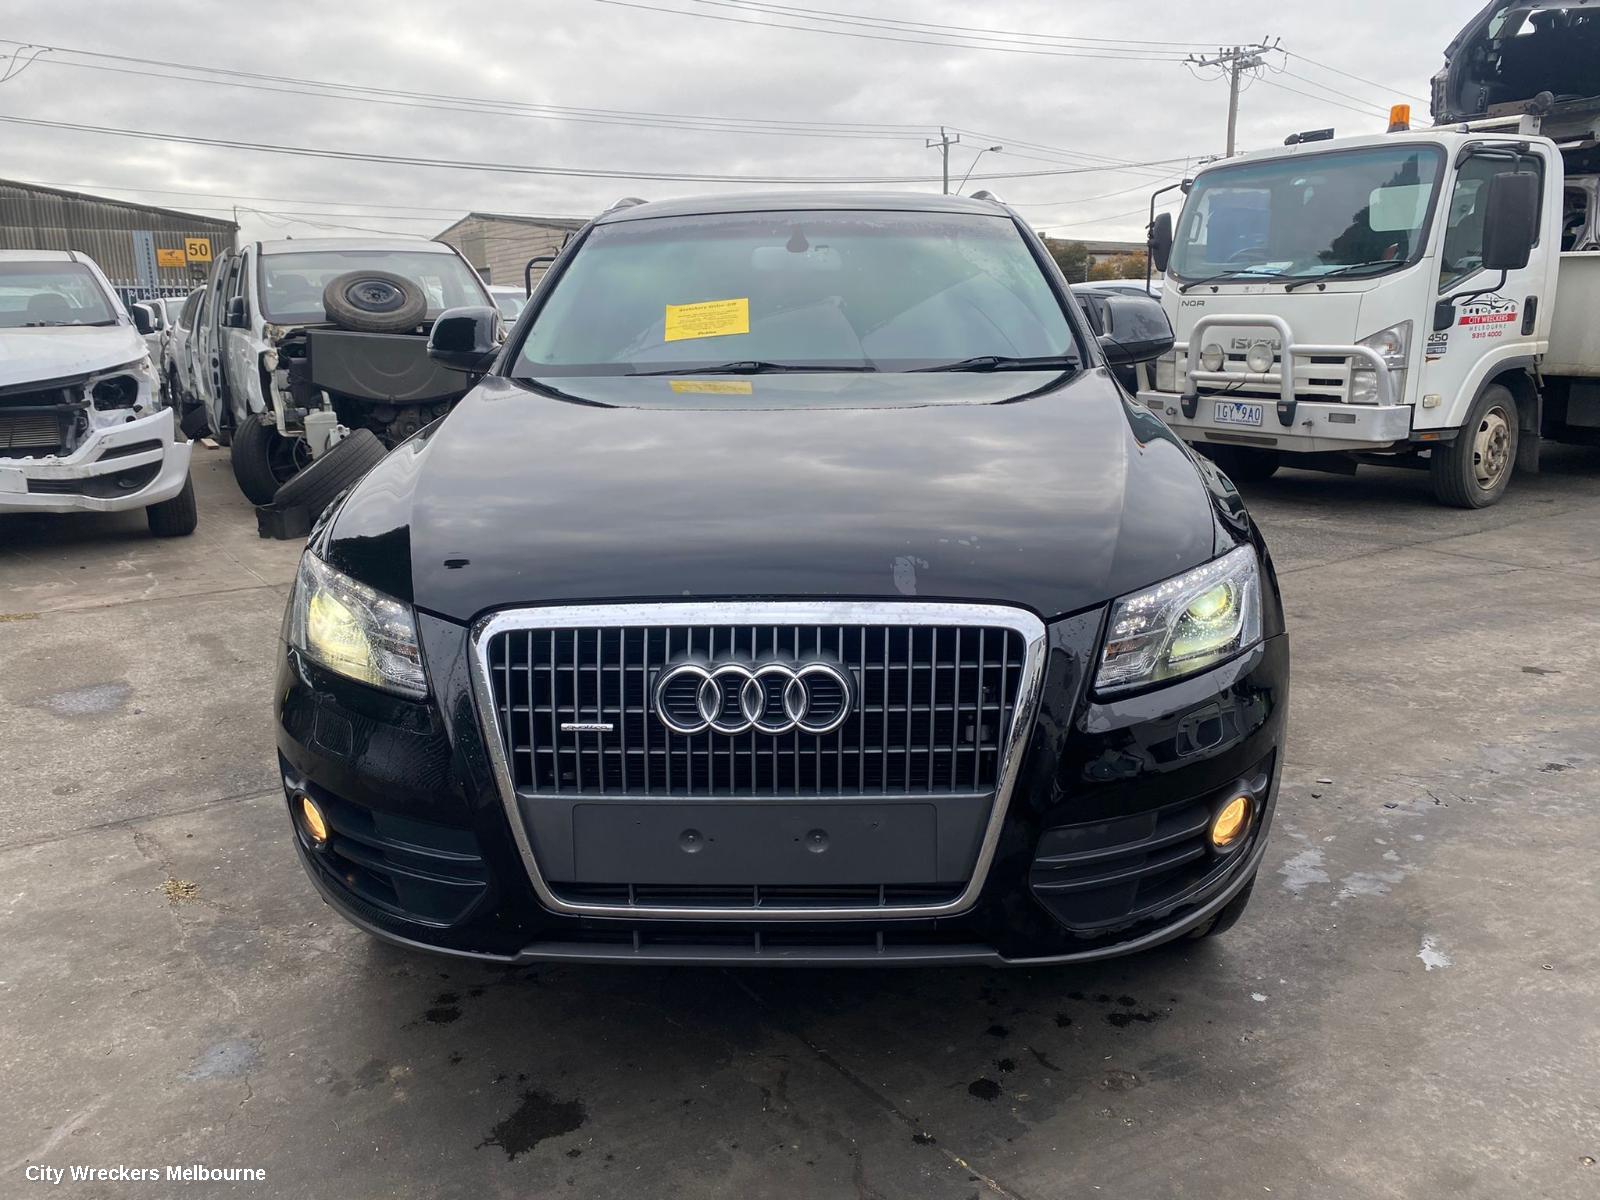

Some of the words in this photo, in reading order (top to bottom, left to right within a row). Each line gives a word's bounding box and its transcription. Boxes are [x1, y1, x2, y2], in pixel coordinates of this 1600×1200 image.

[189, 243, 208, 257] 50
[1468, 316, 1480, 324] CITY
[1481, 314, 1509, 323] WRECKERS
[1428, 333, 1448, 342] 450
